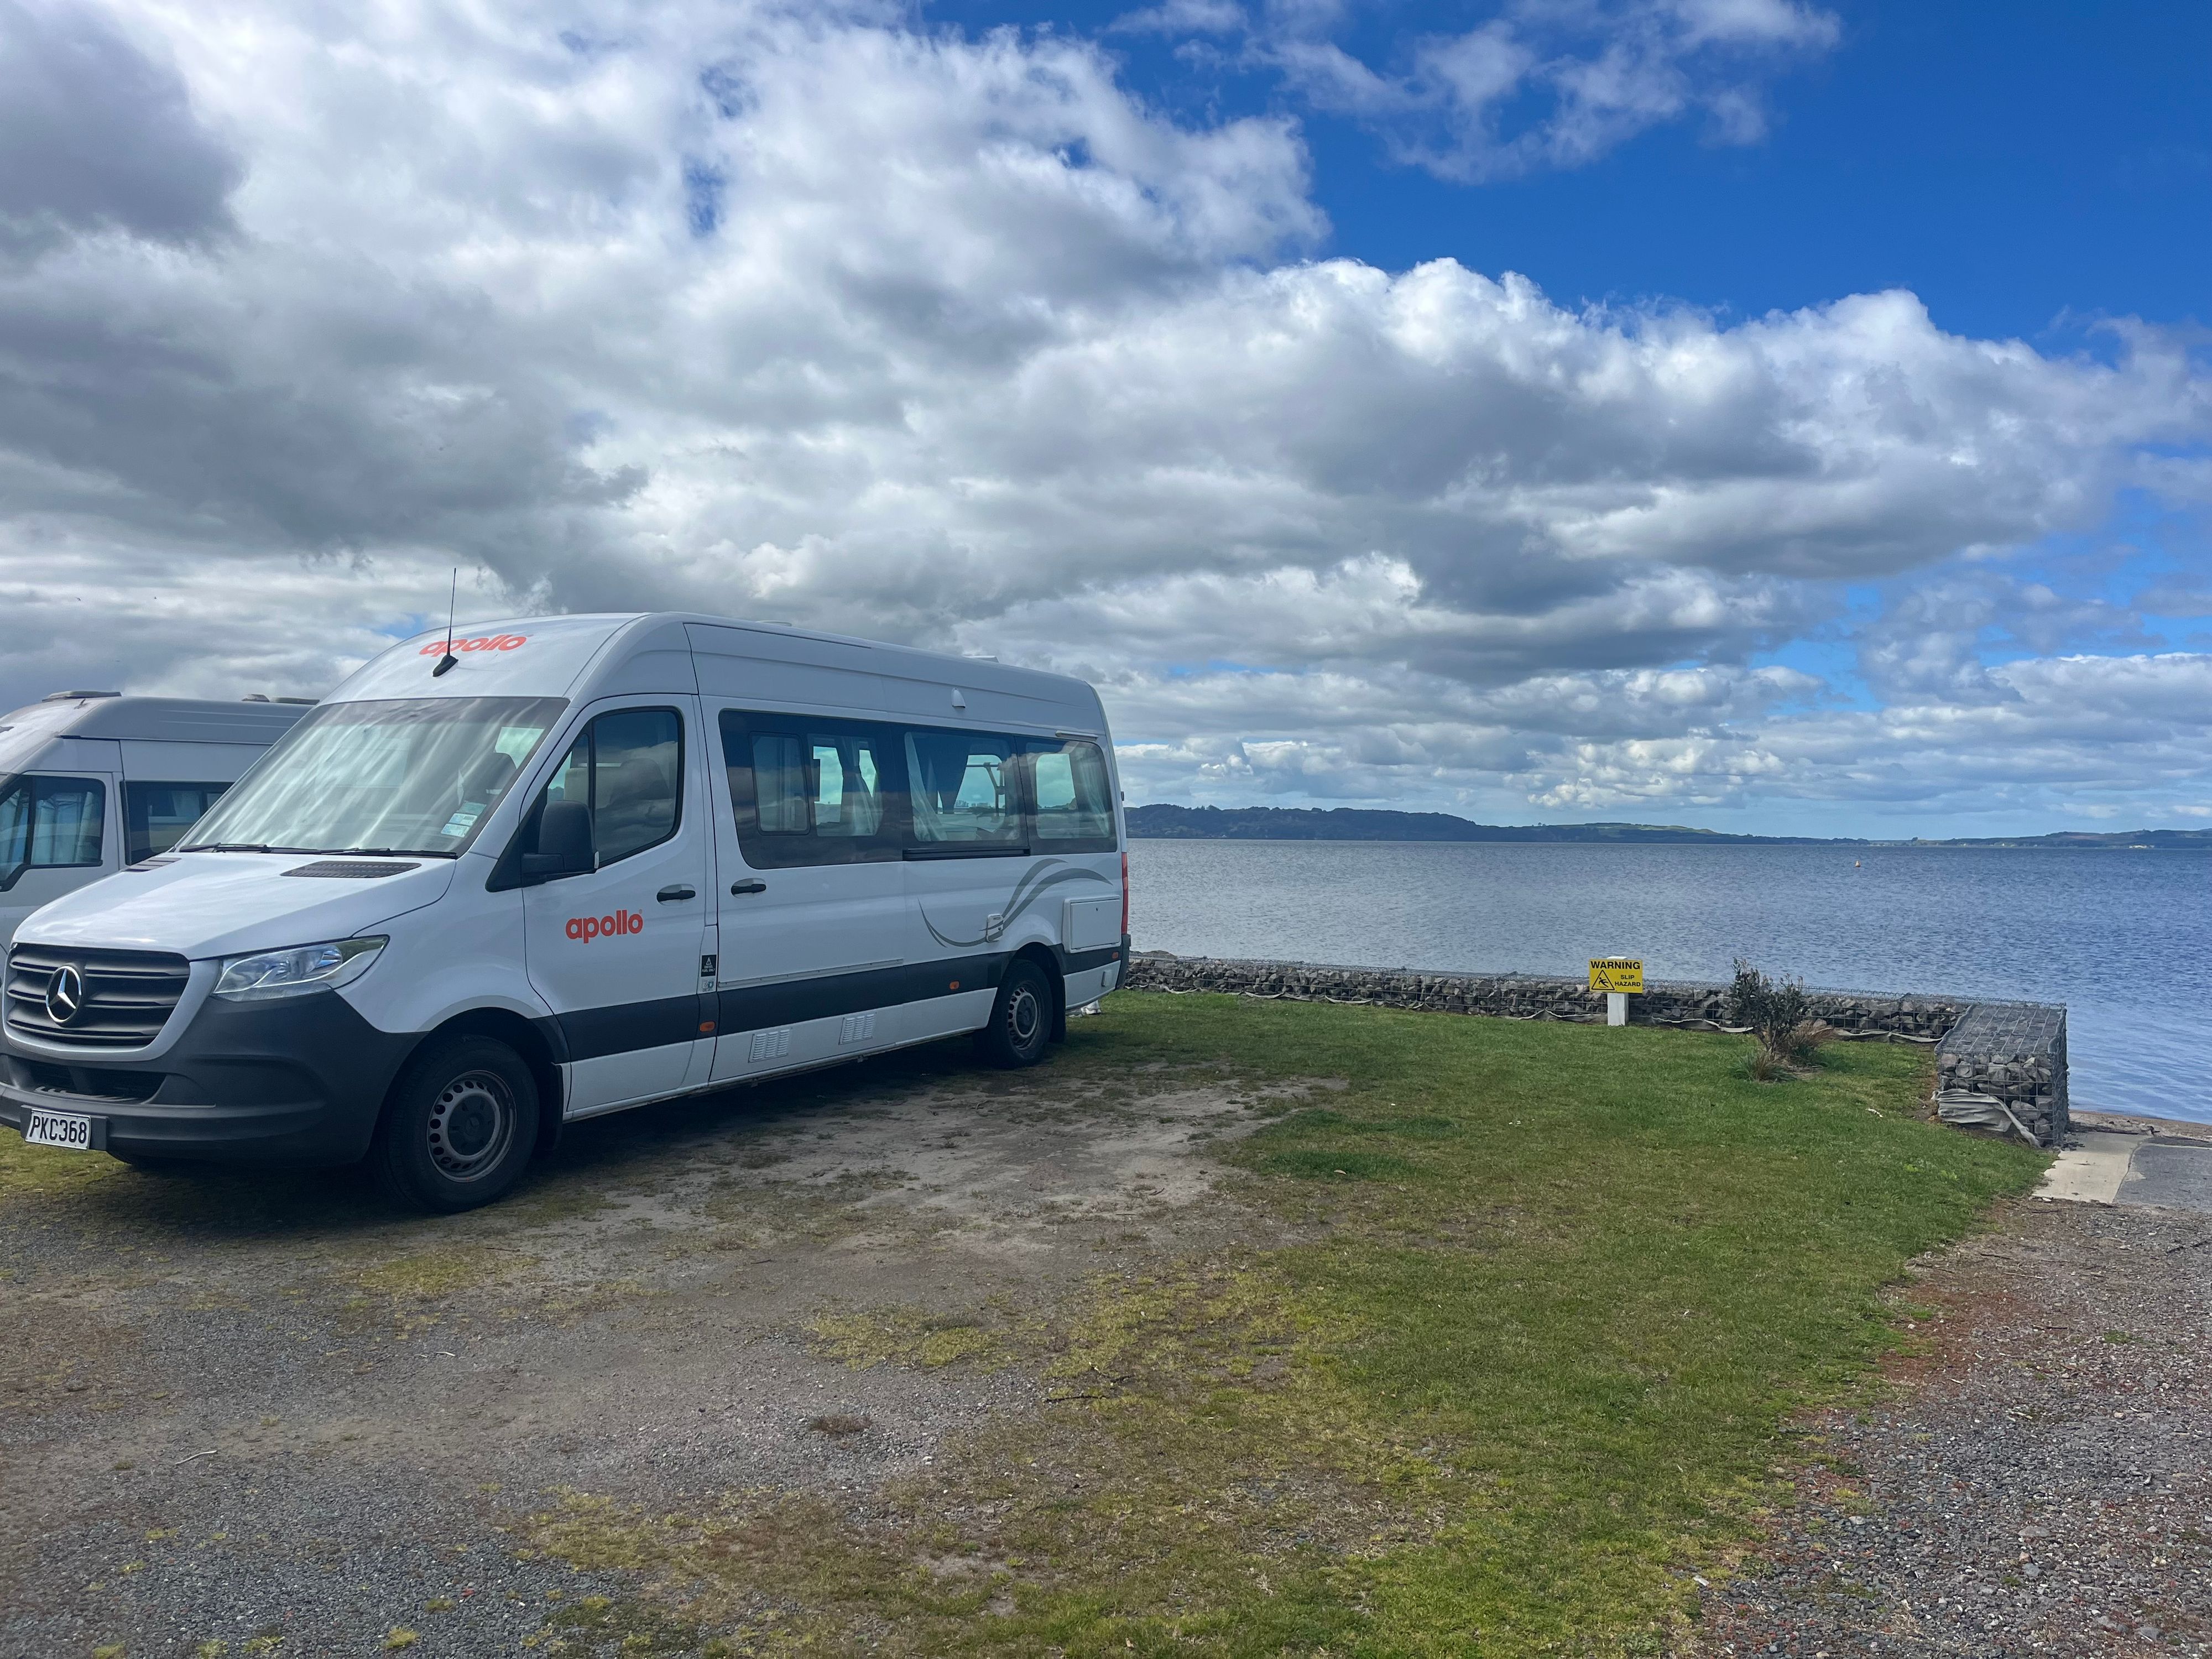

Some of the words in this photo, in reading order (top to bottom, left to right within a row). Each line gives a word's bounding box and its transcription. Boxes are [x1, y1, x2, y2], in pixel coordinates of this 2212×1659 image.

[419, 634, 527, 657] apollo
[565, 909, 643, 943] apollo
[1590, 961, 1640, 969] WARNING
[29, 1115, 87, 1144] PKC368
